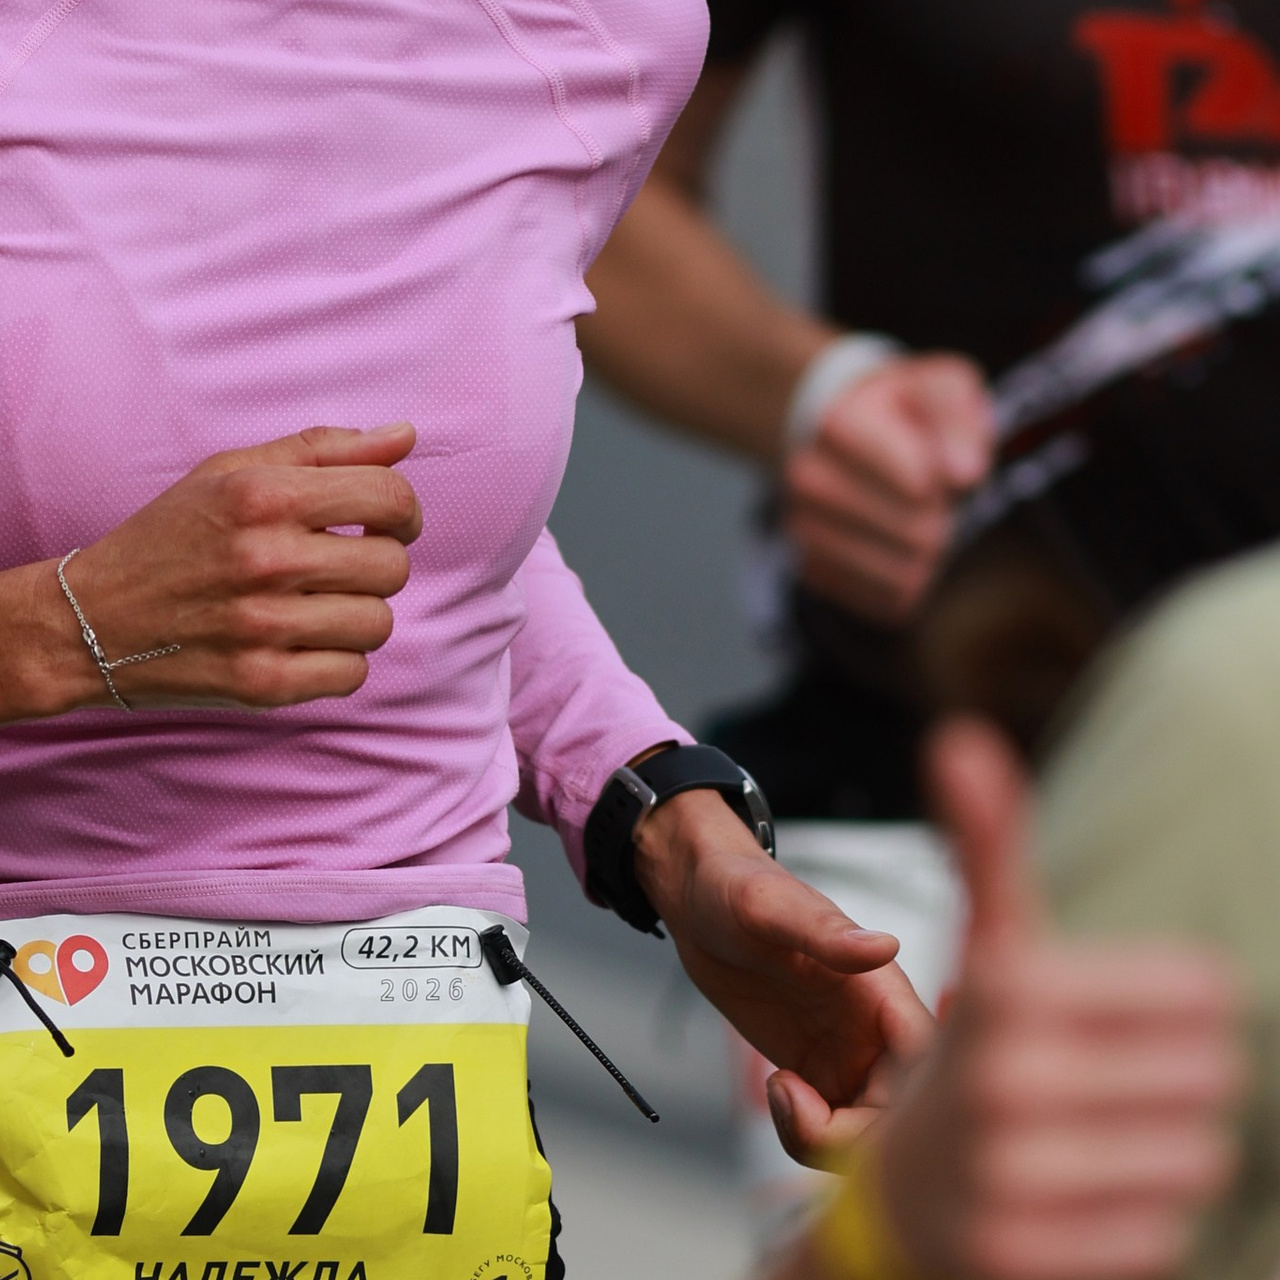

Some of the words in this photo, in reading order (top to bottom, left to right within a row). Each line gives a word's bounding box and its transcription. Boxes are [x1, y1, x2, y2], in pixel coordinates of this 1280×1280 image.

[122, 926, 271, 950] СБЕРПРАЙМ
[358, 934, 419, 962] 42,2
[430, 934, 471, 958] КМ
[125, 949, 325, 977] МОСКОВСКИЙ
[130, 981, 277, 1005] МАРАФОН
[380, 977, 464, 1002] 2026
[66, 1063, 459, 1236] 1971
